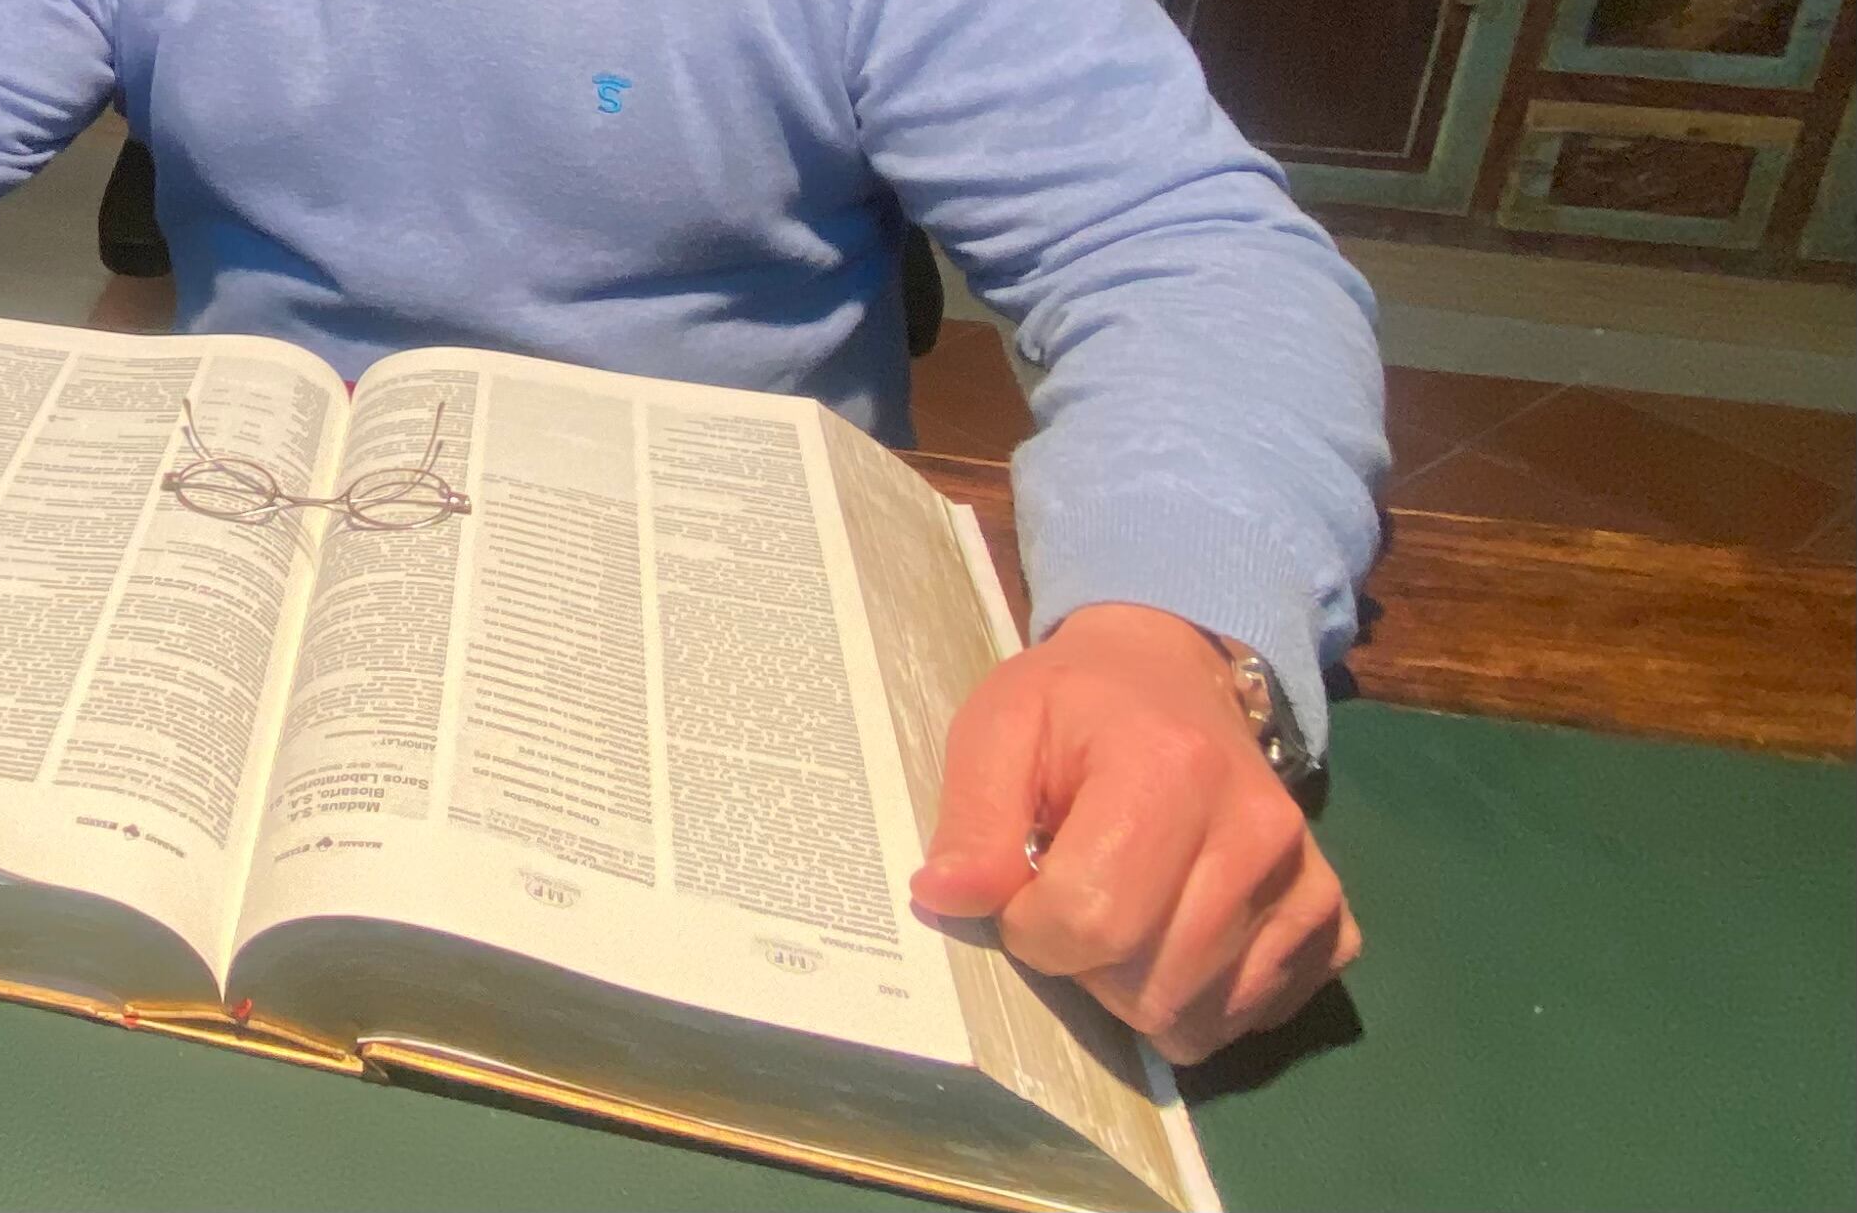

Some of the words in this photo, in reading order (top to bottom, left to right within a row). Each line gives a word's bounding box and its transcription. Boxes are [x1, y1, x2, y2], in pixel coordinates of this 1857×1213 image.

[384, 774, 429, 790] Saros
[318, 787, 384, 798] Biosarto,
[288, 793, 313, 808] S.A.
[318, 802, 381, 813] Madaus,
[503, 790, 563, 812] productos
[287, 807, 312, 822] S.A.
[567, 810, 600, 826] Otros
